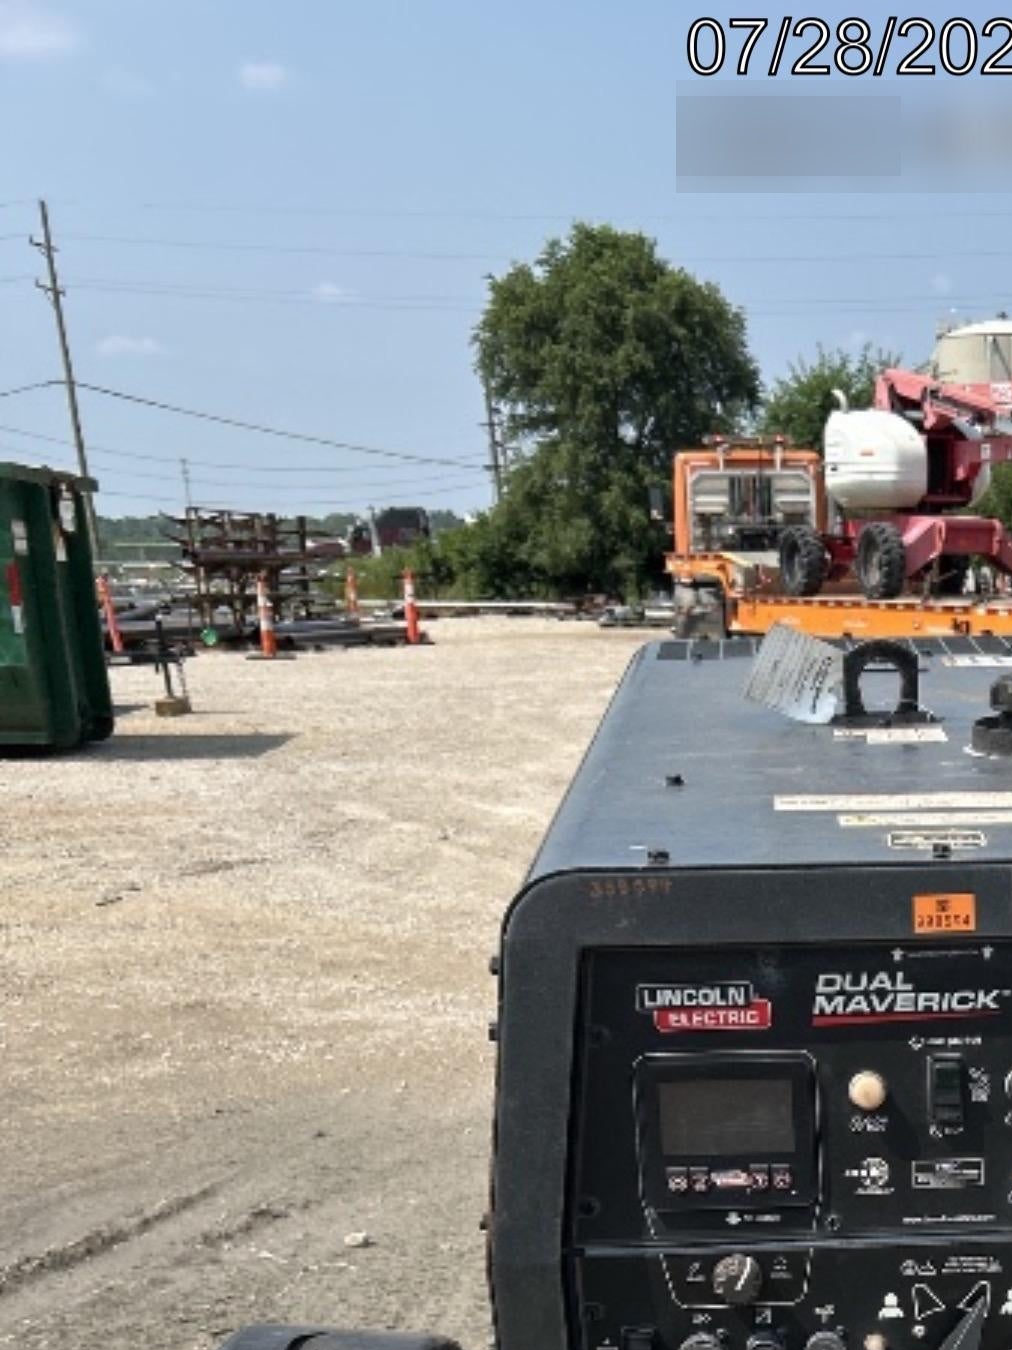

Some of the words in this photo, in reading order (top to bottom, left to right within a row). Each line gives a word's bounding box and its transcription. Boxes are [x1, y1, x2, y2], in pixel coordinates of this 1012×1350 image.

[815, 971, 914, 994] DUAL
[643, 986, 745, 1008] LINCOLN
[812, 989, 1002, 1016] MAVERICK
[668, 1009, 761, 1027] ELECTRIC
